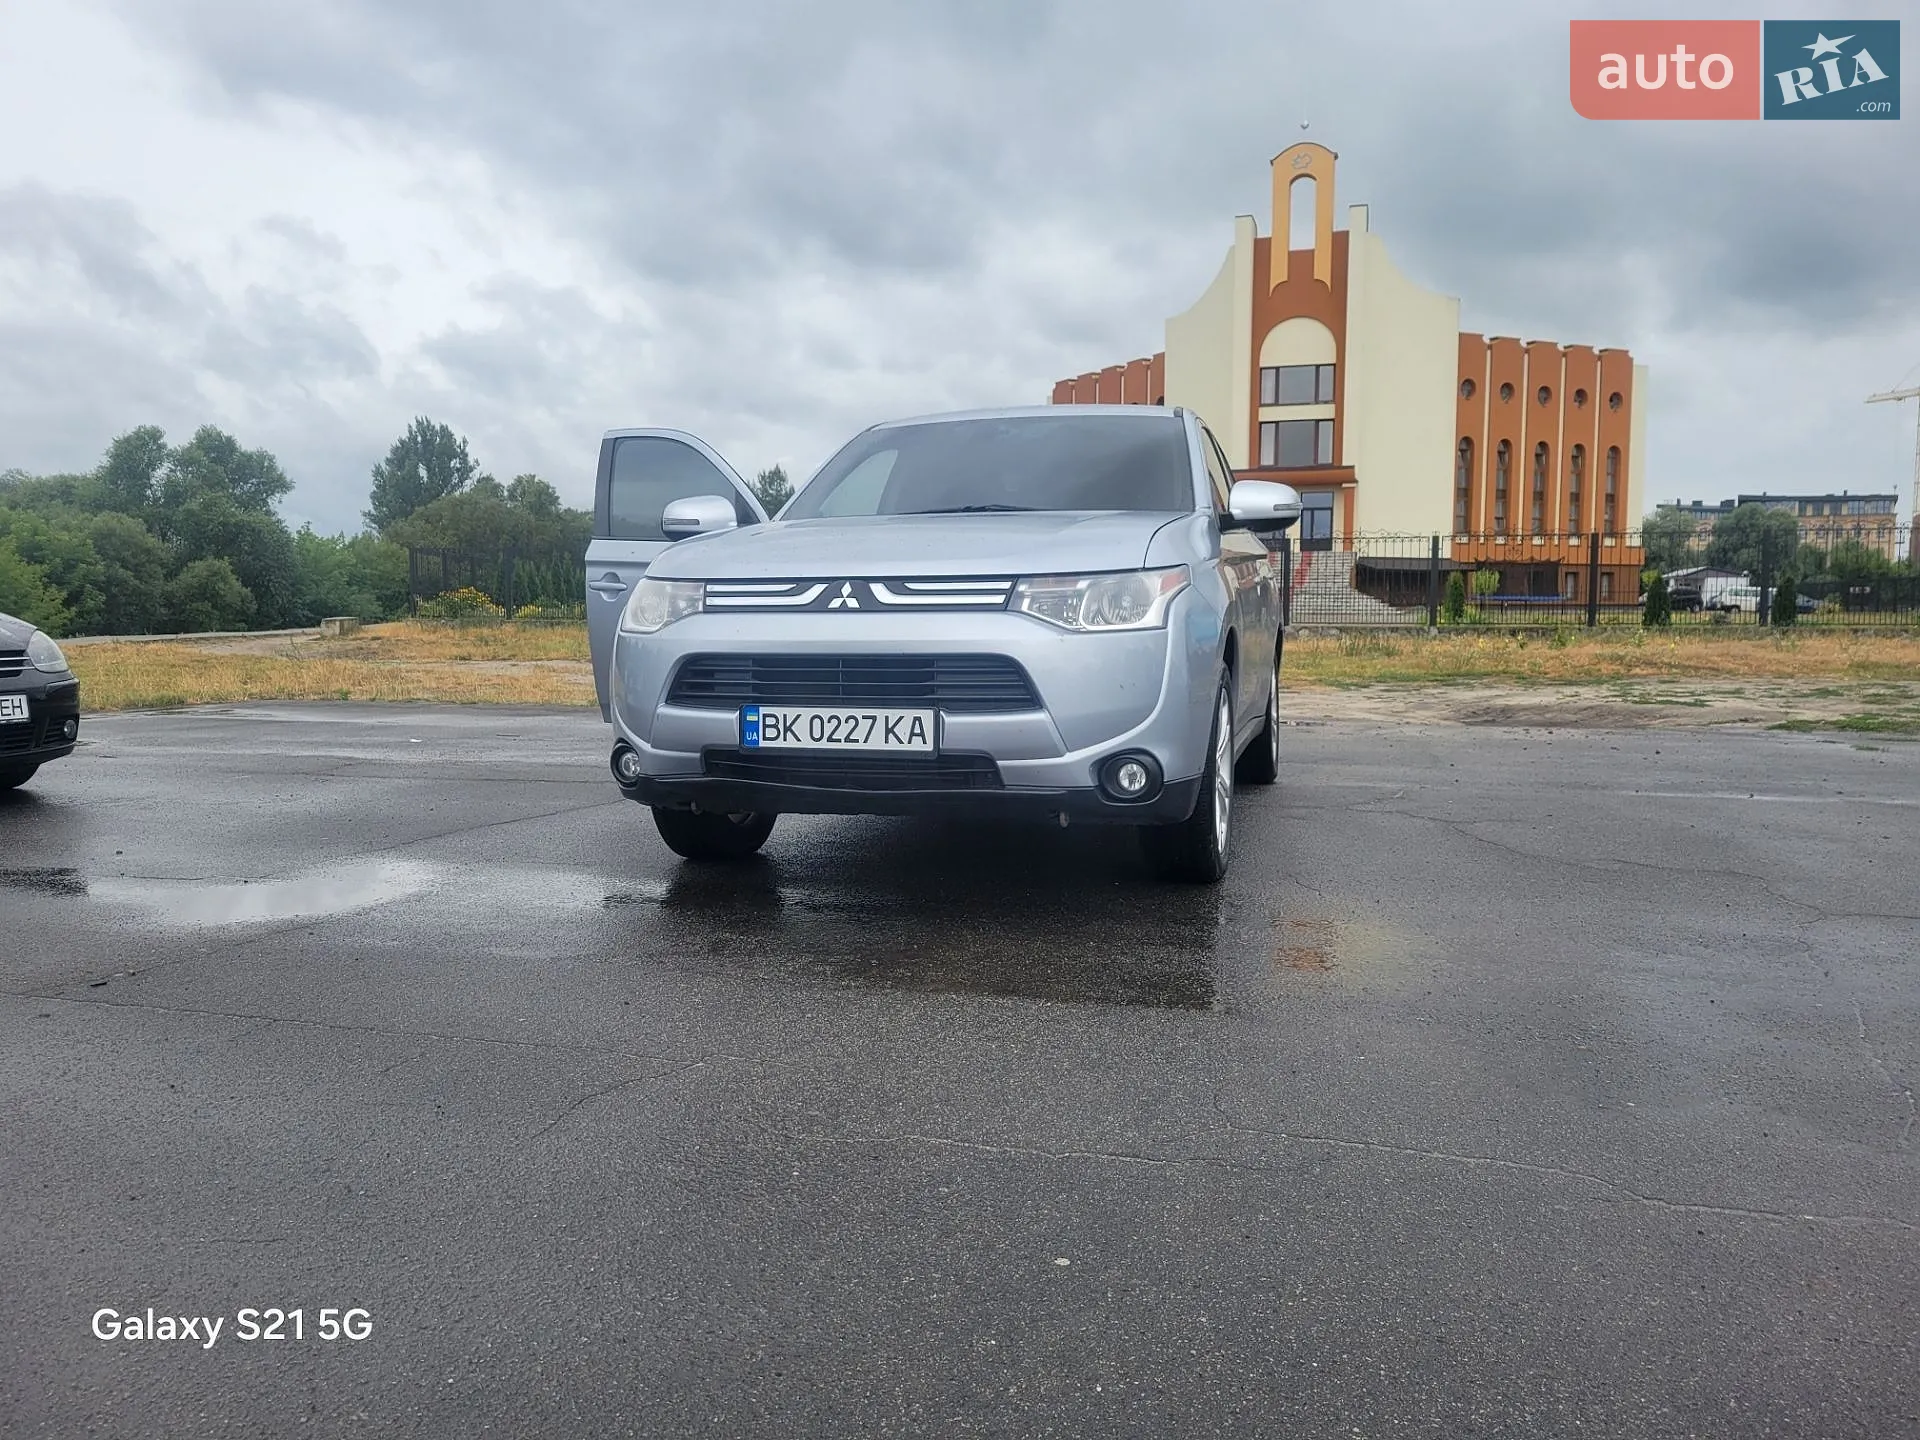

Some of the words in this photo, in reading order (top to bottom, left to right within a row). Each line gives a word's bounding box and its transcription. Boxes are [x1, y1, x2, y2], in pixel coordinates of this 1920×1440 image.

[746, 731, 759, 741] UA
[762, 713, 802, 742] BK
[809, 714, 878, 744] 0227
[884, 715, 928, 745] KA
